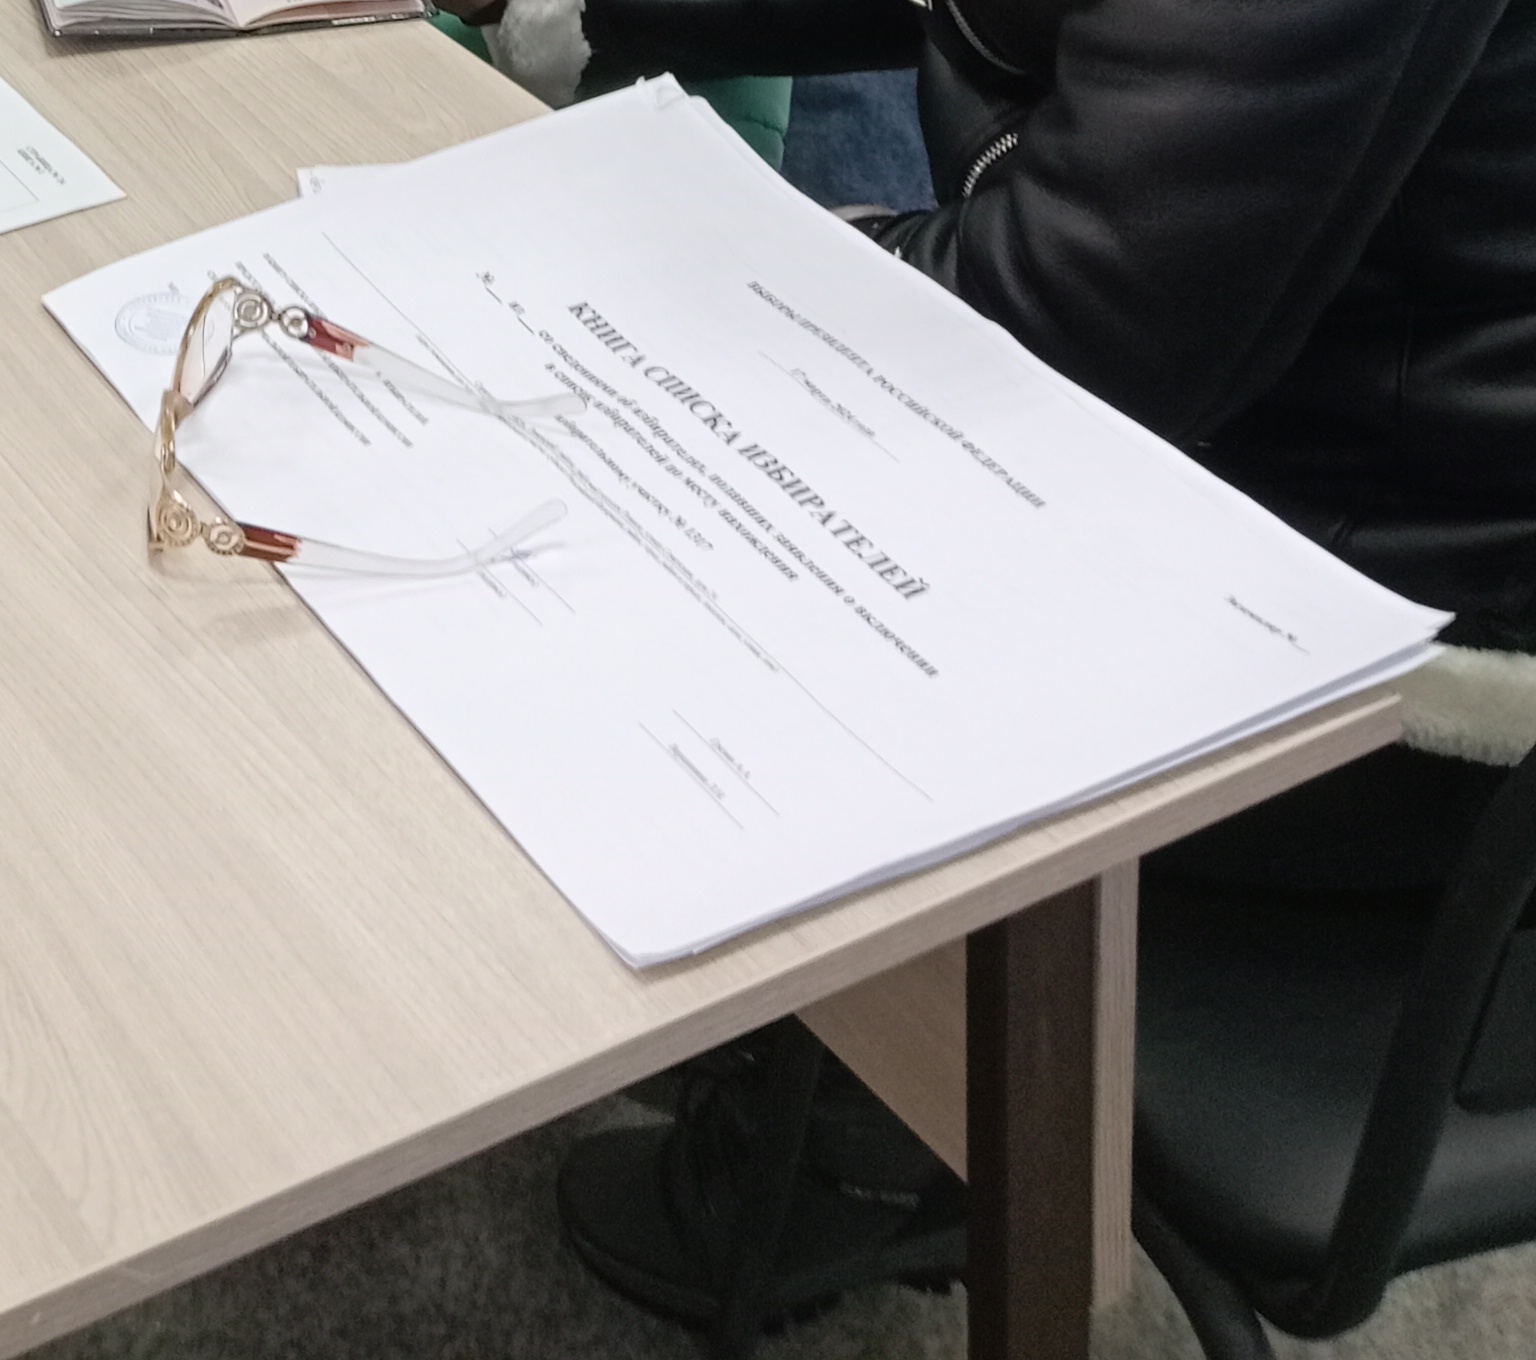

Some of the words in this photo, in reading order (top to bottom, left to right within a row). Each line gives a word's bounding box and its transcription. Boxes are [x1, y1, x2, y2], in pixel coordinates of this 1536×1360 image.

[561, 300, 655, 368] КНИГА
[639, 362, 750, 445] СПИСКА
[730, 440, 935, 601] ИЗБИРАТЕЛЕЙ
[870, 373, 966, 441] РОССИЙСКОЙ
[953, 439, 1052, 510] ФЕДЕРАЦИИ
[675, 476, 721, 509] месту
[712, 508, 804, 582] нахождения
[702, 473, 780, 533] подавших
[768, 532, 848, 596] заявления
[851, 604, 944, 679] включении
